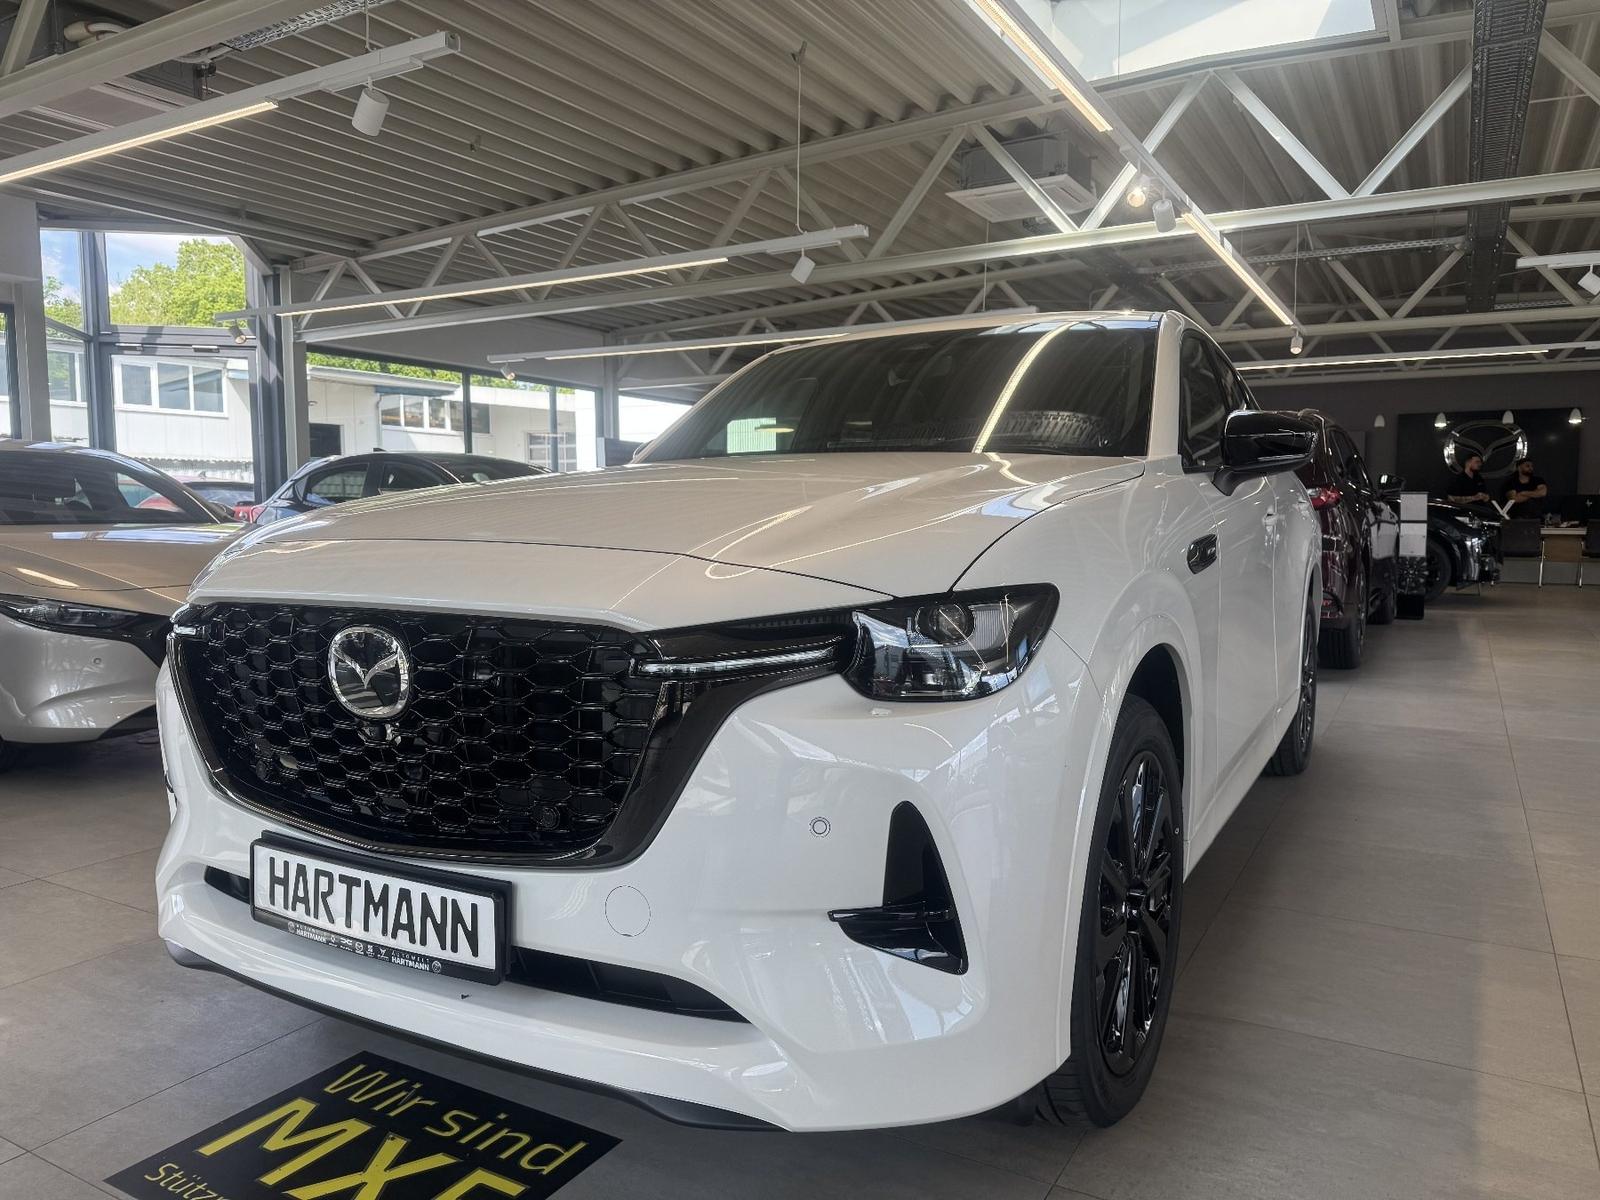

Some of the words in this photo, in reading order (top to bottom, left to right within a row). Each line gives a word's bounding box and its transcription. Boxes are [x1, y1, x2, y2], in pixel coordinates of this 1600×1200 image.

[268, 856, 479, 958] HARTMANN
[391, 956, 430, 971] HARTMANN
[322, 1063, 434, 1118] Wir
[426, 1109, 588, 1176] sind
[143, 1161, 230, 1200] Stütz
